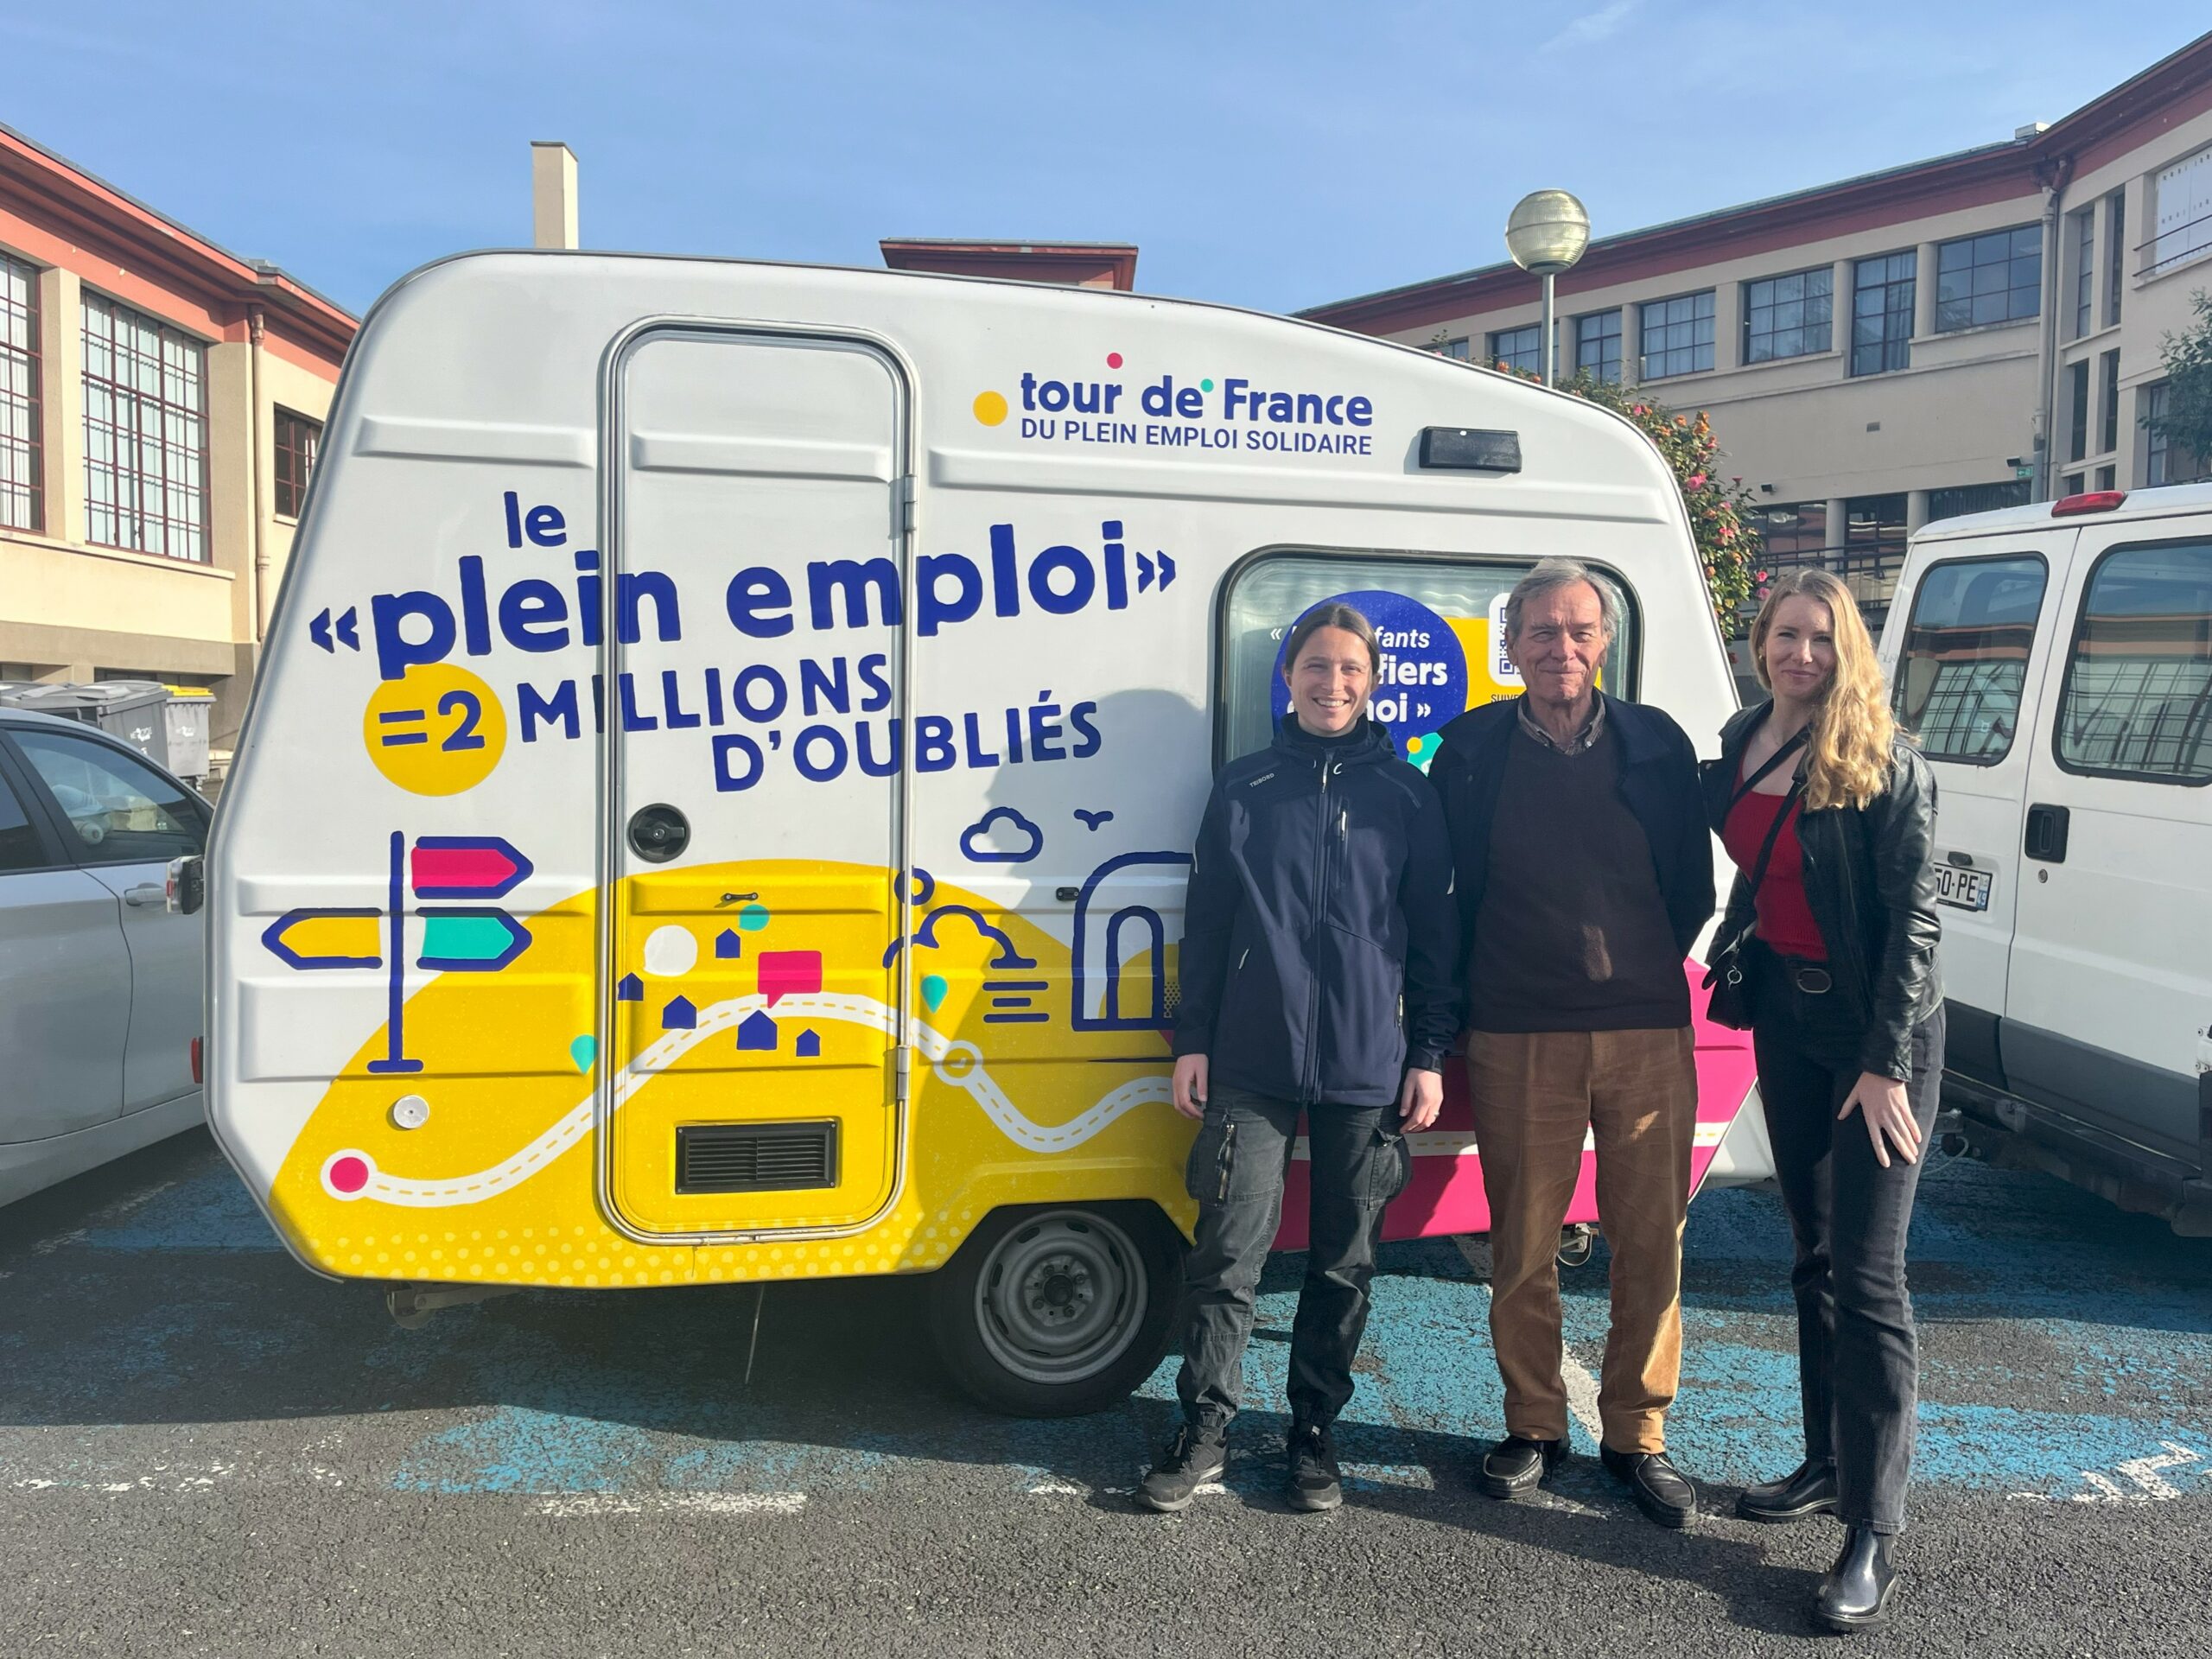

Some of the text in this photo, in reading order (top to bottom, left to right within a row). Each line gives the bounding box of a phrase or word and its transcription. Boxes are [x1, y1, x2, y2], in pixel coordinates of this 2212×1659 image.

[1020, 372, 1373, 427] tour de France
[1020, 418, 1372, 455] DU PLEIN EMPLOI SOLIDAIRE
[505, 492, 567, 547] le
[1376, 626, 1431, 648] fants
[518, 653, 893, 743] MILLIONS
[711, 690, 1102, 792] D'OUBLIÉS
[1249, 772, 1274, 788] TRIBORD
